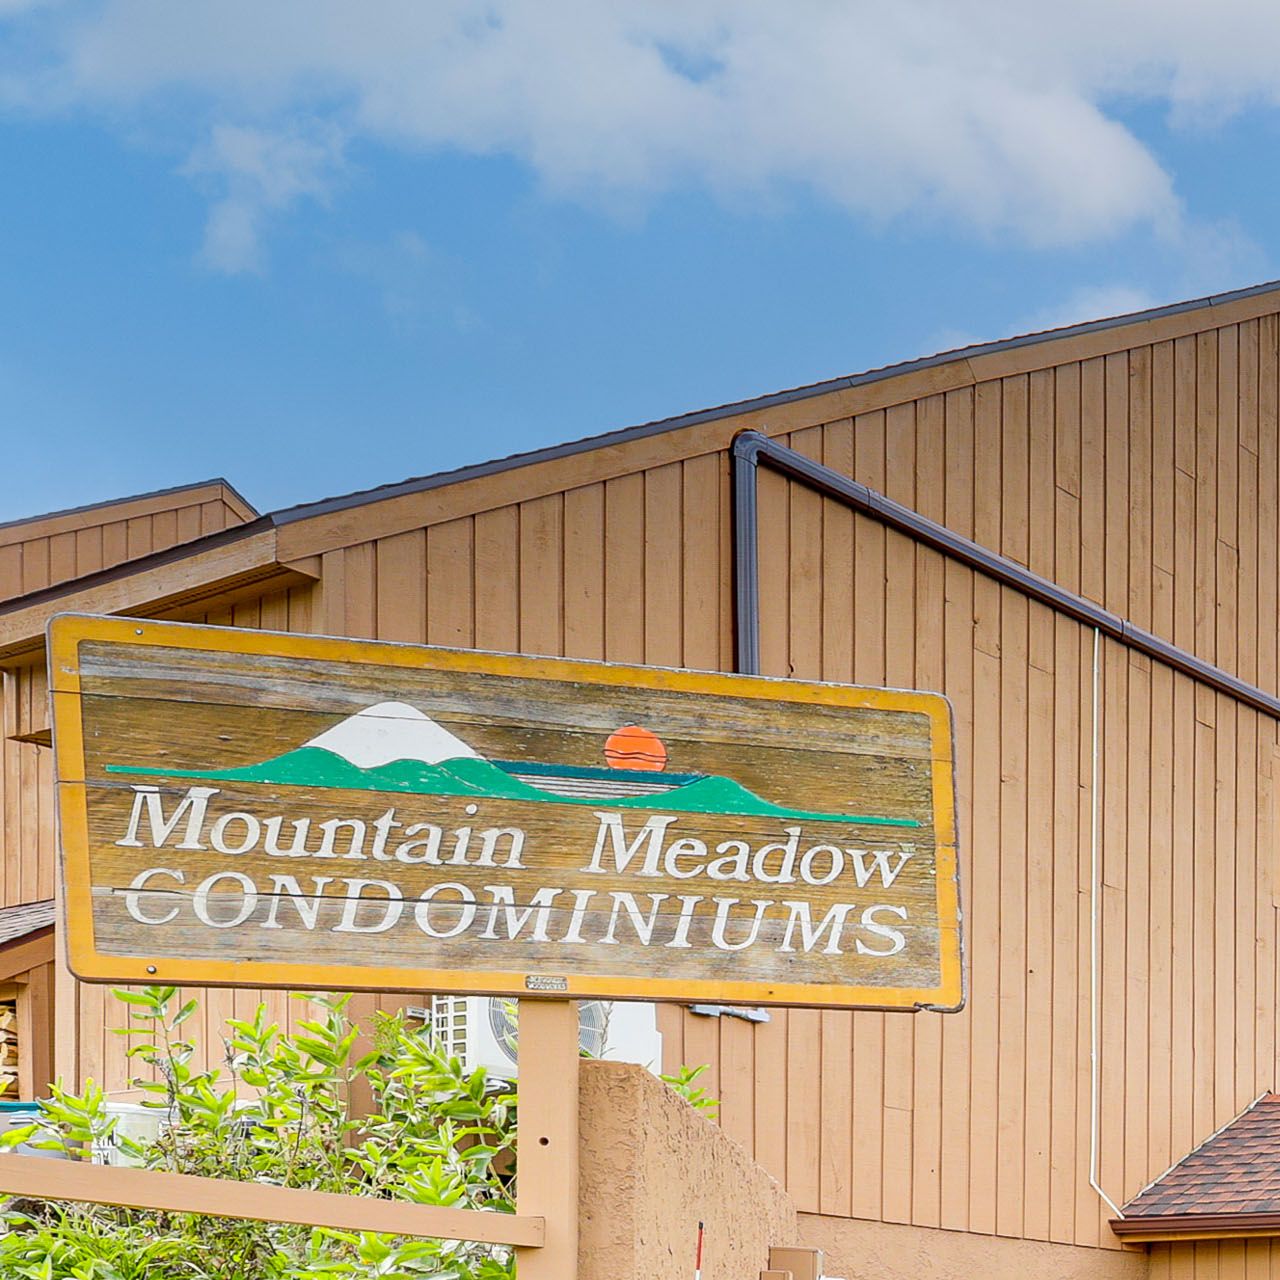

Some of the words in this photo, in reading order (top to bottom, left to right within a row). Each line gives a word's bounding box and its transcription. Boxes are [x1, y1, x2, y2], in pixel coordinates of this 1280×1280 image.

[114, 784, 527, 869] Mountain
[580, 811, 912, 889] Meadow
[124, 867, 908, 957] CONDOMINIUMS
